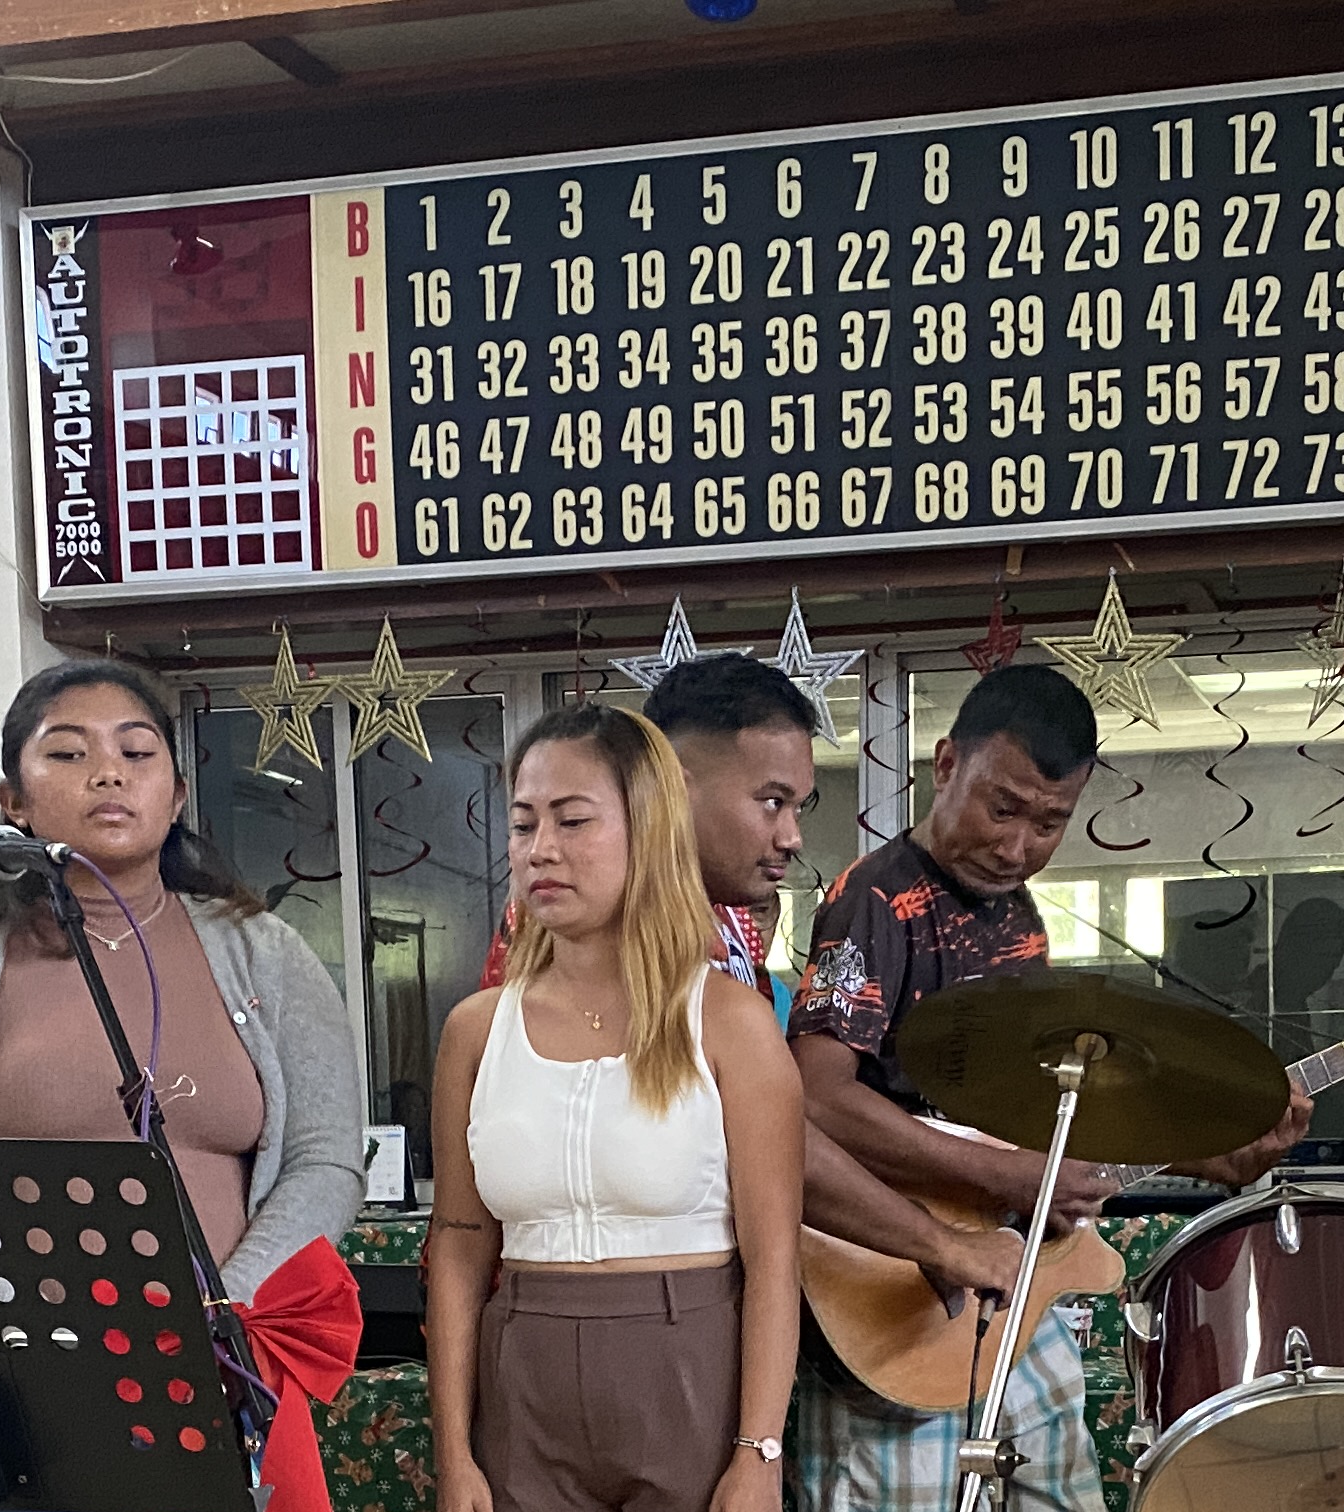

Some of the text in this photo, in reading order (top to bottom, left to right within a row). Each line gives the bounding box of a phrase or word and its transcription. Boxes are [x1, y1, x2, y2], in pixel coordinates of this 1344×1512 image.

[419, 195, 437, 251] 1
[487, 188, 512, 246] 2
[559, 180, 583, 239] 3
[629, 174, 655, 231] 4
[702, 165, 727, 225] 5
[777, 157, 802, 219] 6
[852, 151, 878, 212] 7
[924, 143, 950, 205] 8
[1002, 135, 1028, 198] 9
[1069, 126, 1117, 190] 10
[1152, 117, 1193, 181] 11
[1227, 110, 1277, 175] 12
[407, 268, 452, 328] 16
[478, 262, 522, 322] 17
[550, 255, 595, 316] 18
[621, 249, 666, 310] 19
[689, 242, 743, 305] 20
[766, 236, 814, 298] 21
[837, 229, 891, 292] 22
[911, 222, 966, 286] 23
[987, 215, 1044, 280] 24
[1064, 206, 1120, 272] 25
[1143, 198, 1200, 264] 26
[1222, 193, 1281, 258] 27
[48, 254, 97, 523] AUTOTRONIC
[409, 345, 454, 405] 31
[477, 339, 529, 400] 32
[548, 332, 600, 395] 33
[618, 327, 671, 389] 34
[691, 320, 743, 383] 35
[765, 313, 818, 377] 36
[840, 309, 891, 371] 37
[912, 302, 967, 366] 38
[989, 295, 1044, 360] 39
[1066, 288, 1123, 351] 40
[1146, 281, 1196, 344] 41
[1222, 275, 1282, 338] 42
[409, 420, 461, 480] 46
[479, 416, 530, 475] 47
[550, 409, 603, 470] 48
[620, 404, 673, 465] 49
[693, 398, 745, 460] 50
[770, 393, 816, 455] 51
[841, 388, 893, 450] 52
[914, 381, 968, 445] 53
[990, 375, 1046, 439] 54
[1068, 368, 1123, 432] 55
[1146, 361, 1202, 426] 56
[1224, 356, 1281, 420] 57
[55, 522, 101, 540] 7000
[55, 541, 102, 558] 5000
[414, 497, 460, 557] 61
[482, 491, 533, 552] 62
[552, 486, 604, 547] 63
[621, 482, 674, 543] 64
[694, 476, 746, 538] 65
[767, 470, 820, 533] 66
[841, 466, 893, 528] 67
[914, 460, 969, 523] 68
[991, 454, 1046, 518] 69
[1067, 448, 1123, 511] 70
[1149, 442, 1199, 505] 71
[1222, 437, 1280, 500] 72
